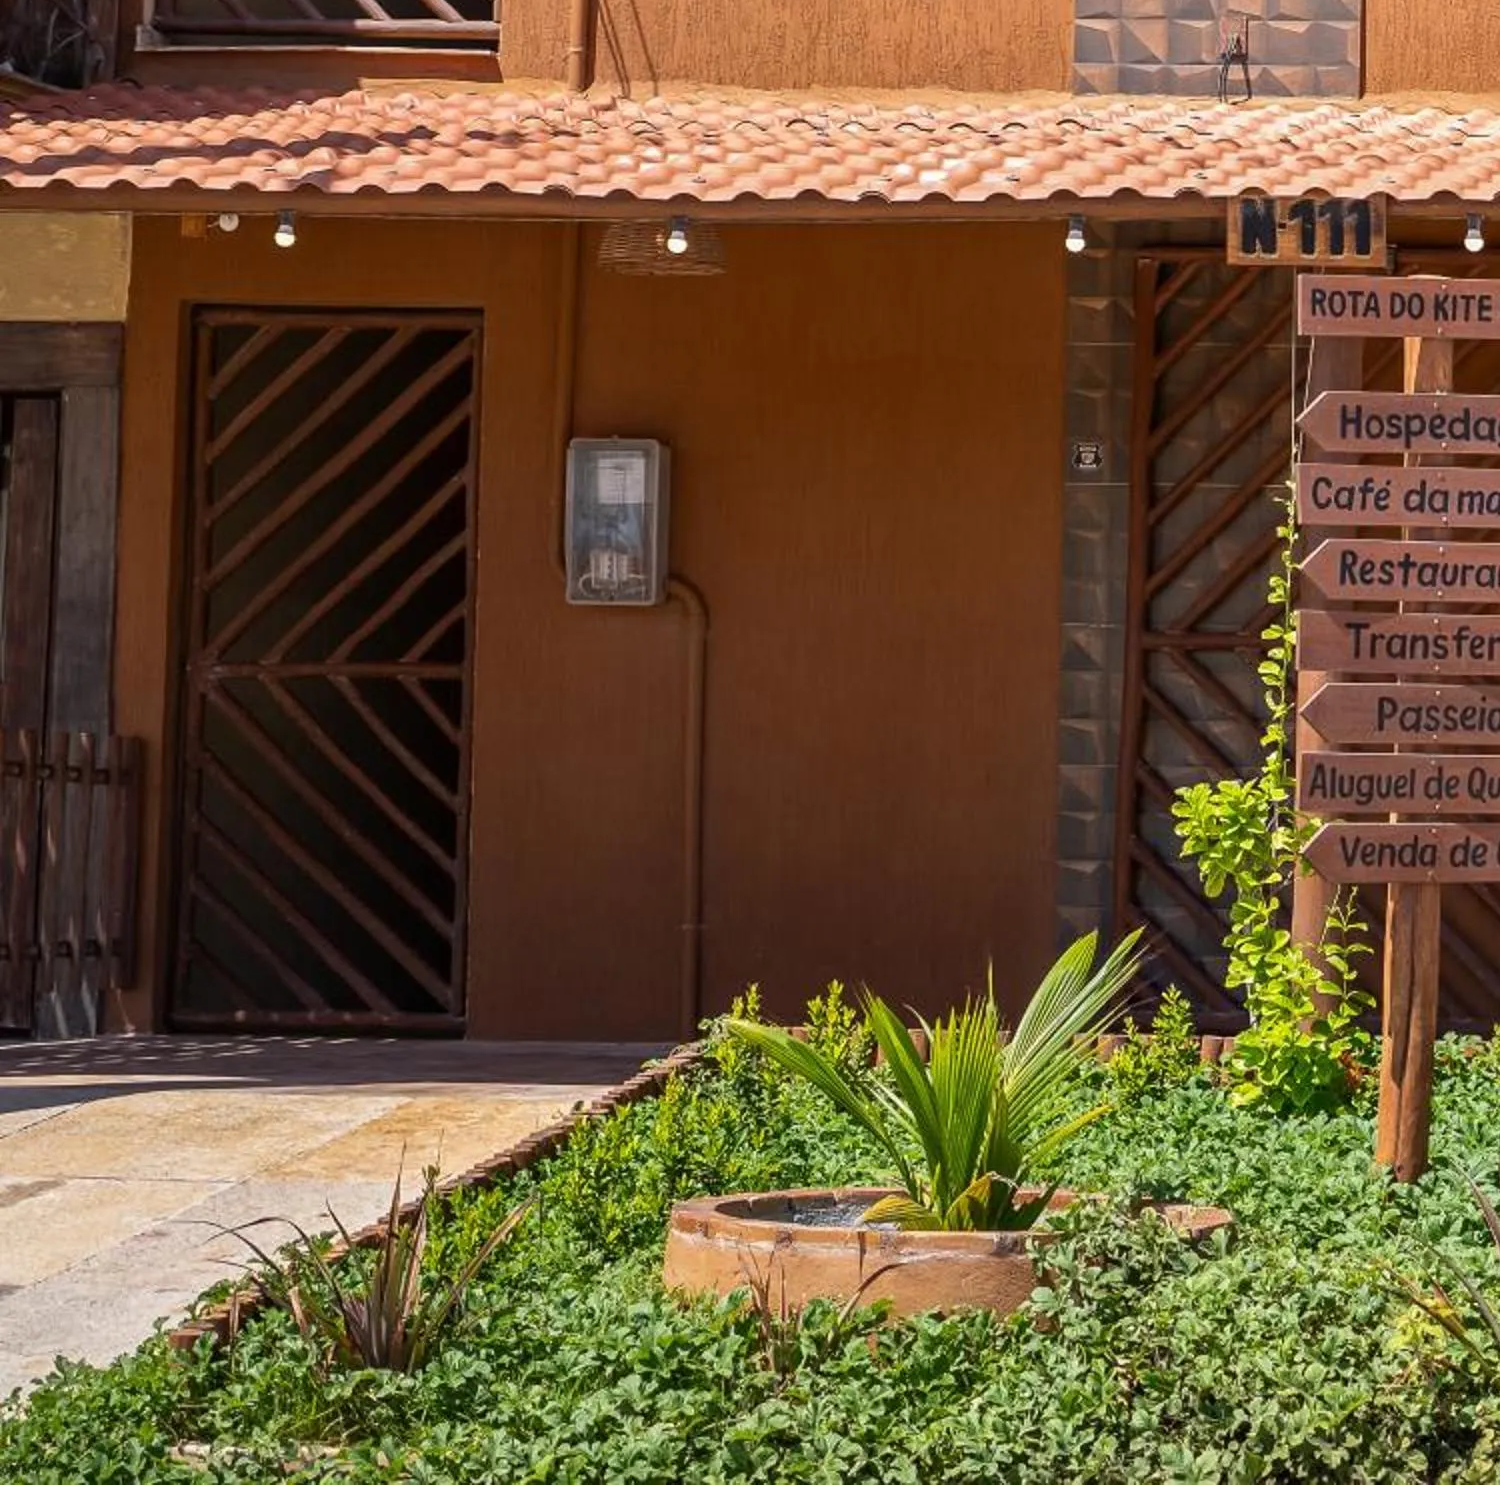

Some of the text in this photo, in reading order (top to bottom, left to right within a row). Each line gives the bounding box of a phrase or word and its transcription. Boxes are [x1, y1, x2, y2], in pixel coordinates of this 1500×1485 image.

[1310, 289, 1381, 318] ROTA
[1390, 293, 1425, 320] DO
[1434, 293, 1493, 323] KITE
[1312, 477, 1391, 512] Café
[1403, 480, 1449, 514] da
[1309, 763, 1415, 804] Aluguel
[1423, 767, 1458, 800] de
[1340, 836, 1436, 868] Venda
[1451, 835, 1487, 866] de
